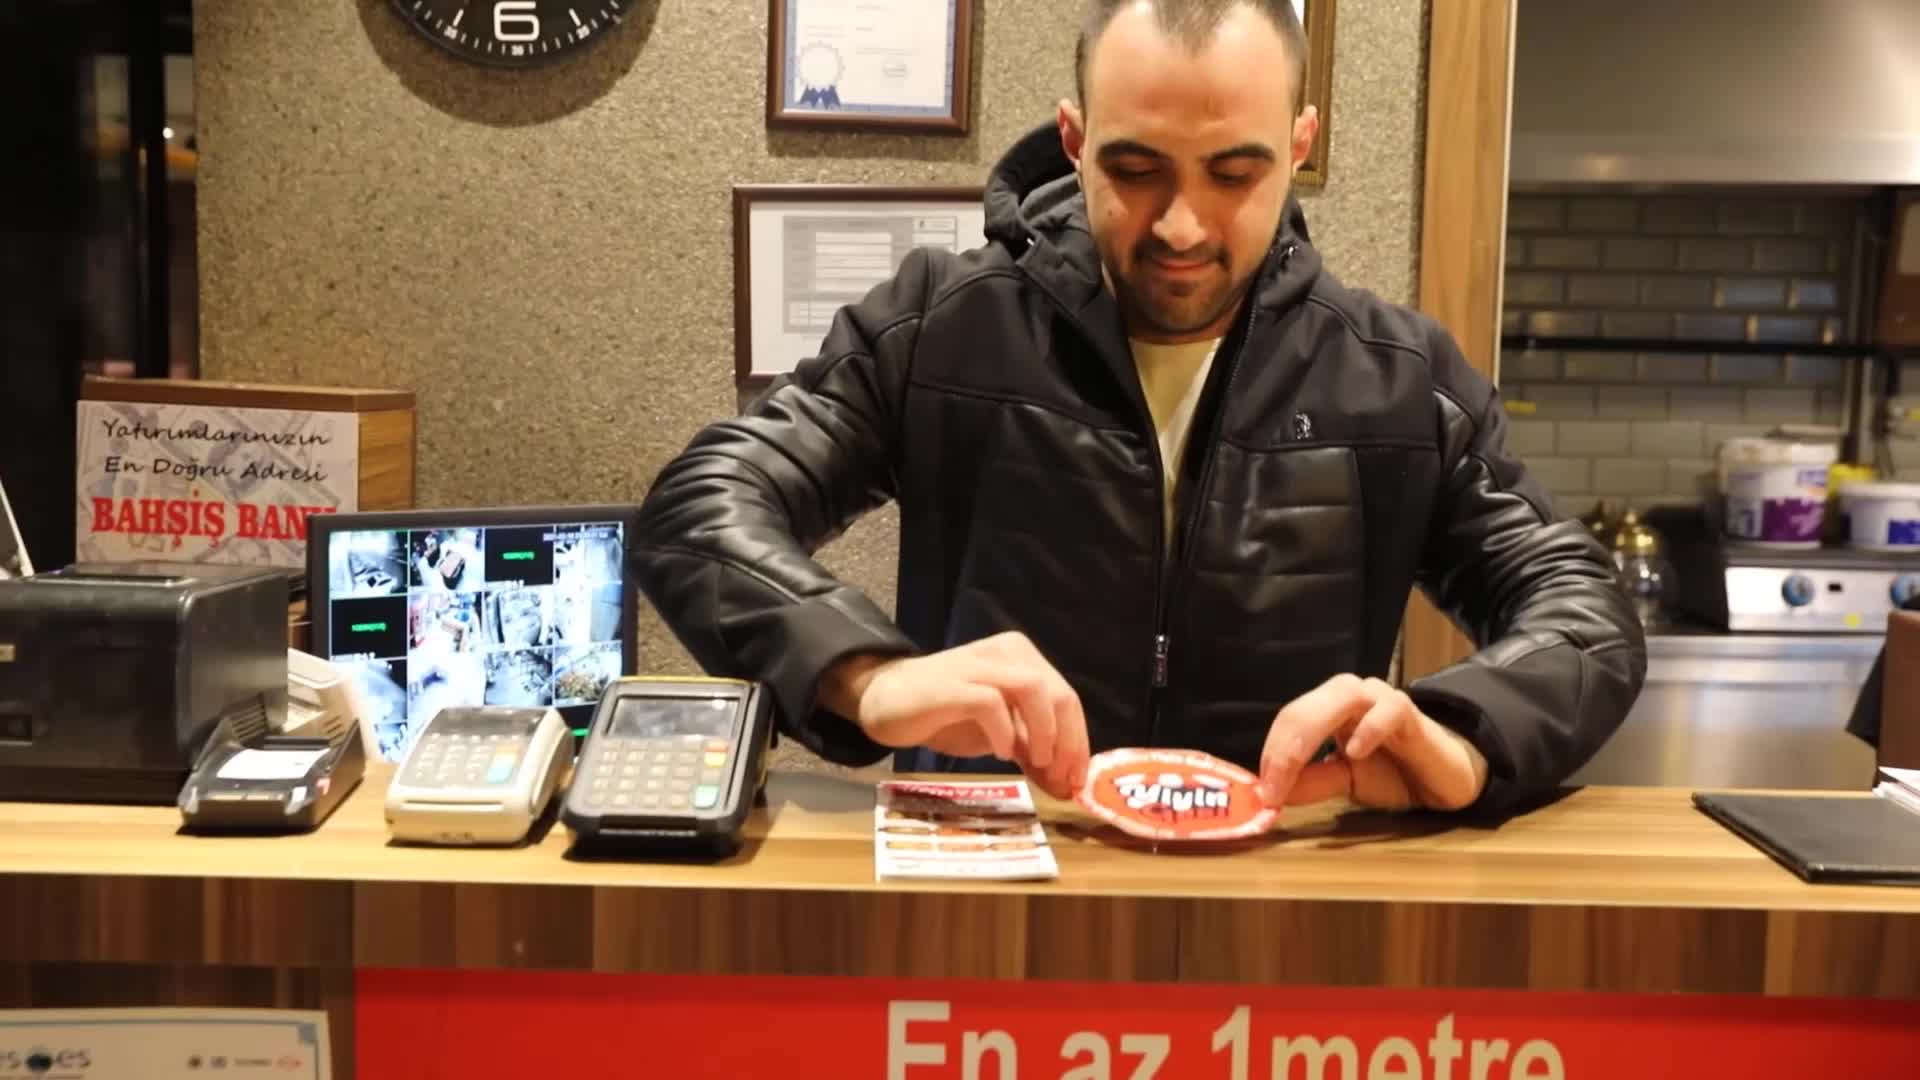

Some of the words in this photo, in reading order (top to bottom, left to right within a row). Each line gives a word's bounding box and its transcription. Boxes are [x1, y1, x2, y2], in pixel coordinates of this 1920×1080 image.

[493, 1, 540, 42] 6
[102, 418, 330, 446] Yatırımlarınızın
[104, 456, 143, 474] En
[152, 457, 231, 482] Doğru
[240, 462, 329, 483] Adresi
[91, 488, 225, 548] BAHŞİŞ
[236, 503, 337, 541] BAN
